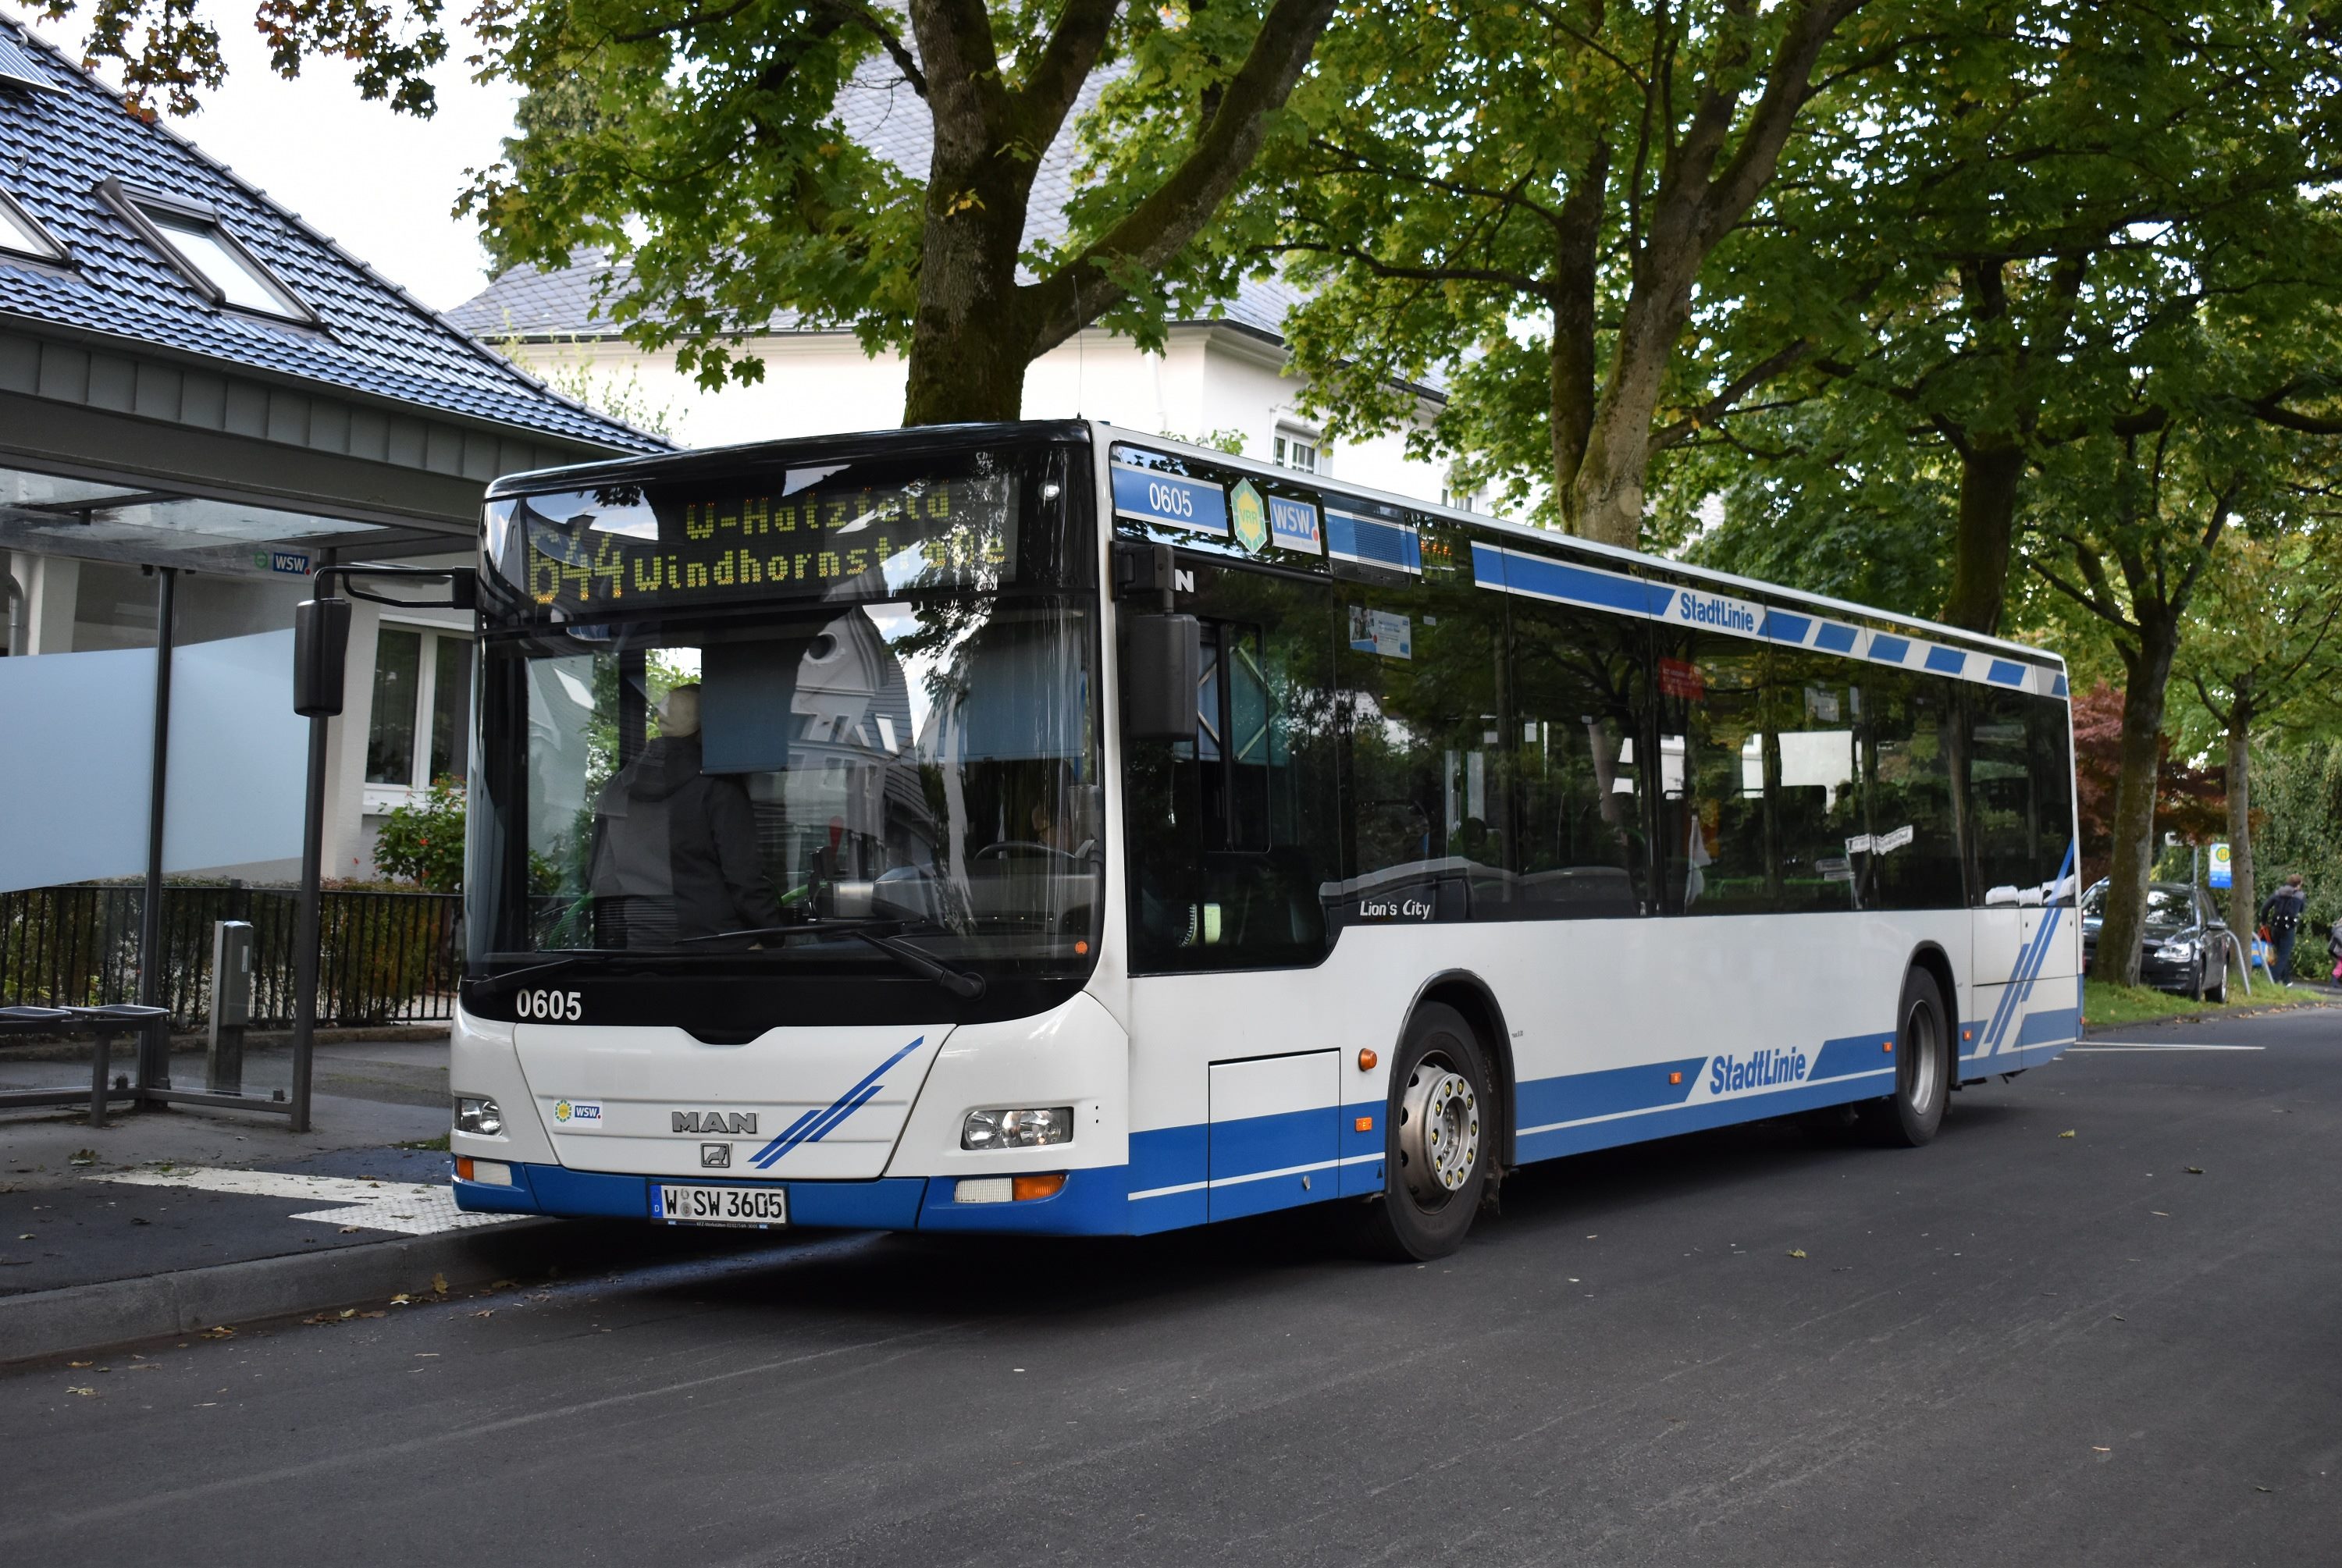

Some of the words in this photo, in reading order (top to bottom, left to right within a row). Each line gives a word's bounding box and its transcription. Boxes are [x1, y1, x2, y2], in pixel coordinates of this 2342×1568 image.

[1149, 482, 1193, 517] 0605
[1239, 508, 1258, 525] VRR
[1272, 503, 1310, 535] WSW
[276, 555, 305, 572] WSW
[529, 526, 624, 604] 644
[1680, 592, 1754, 632] StadtLinie
[1360, 901, 1397, 916] Lion's
[1402, 899, 1430, 920] City
[516, 988, 582, 1021] 0605
[1710, 1047, 1806, 1095] StadtLinie
[575, 1107, 597, 1118] WSW
[671, 1111, 757, 1134] MAN
[664, 1189, 677, 1214] W
[693, 1190, 721, 1217] SW
[727, 1192, 782, 1219] 3605
